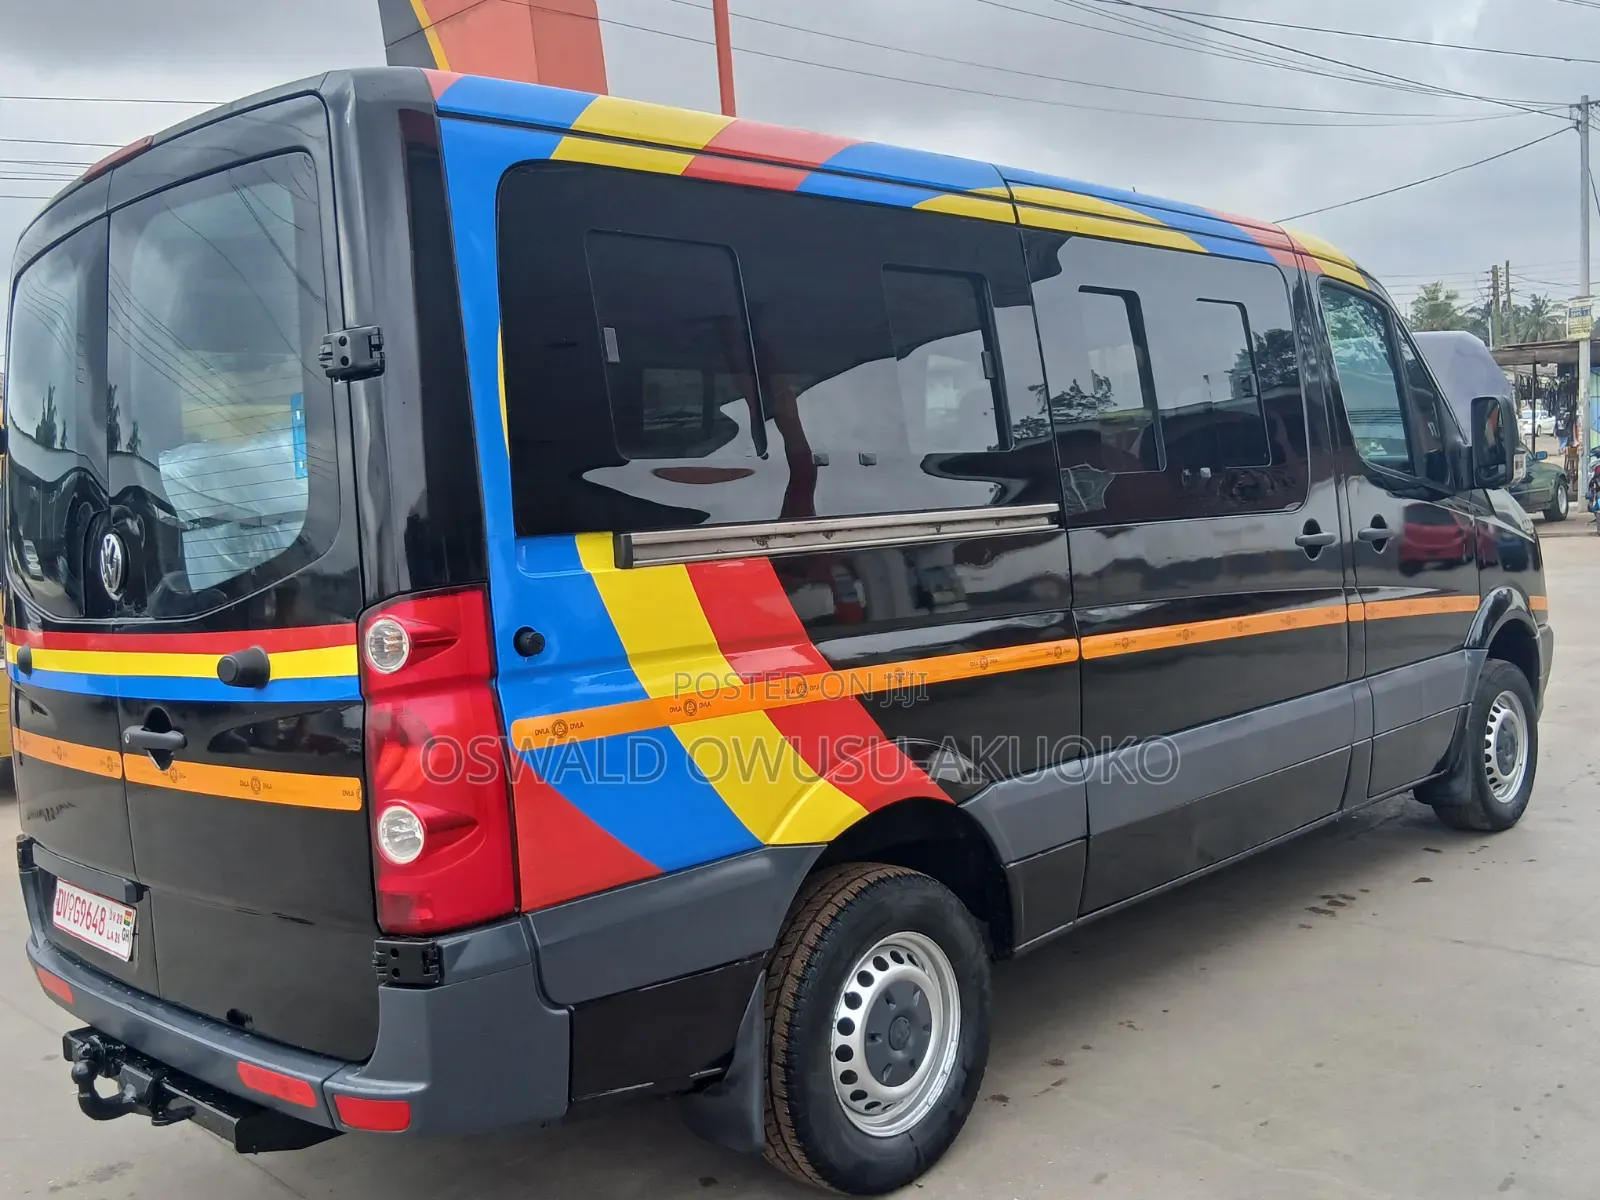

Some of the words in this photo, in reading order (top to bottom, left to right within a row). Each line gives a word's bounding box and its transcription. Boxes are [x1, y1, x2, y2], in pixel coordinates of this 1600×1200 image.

[669, 705, 682, 714] DVLA
[698, 701, 712, 709] DVLA
[534, 728, 550, 737] DVLA
[569, 721, 585, 731] DVLA
[342, 789, 355, 798] DVLA
